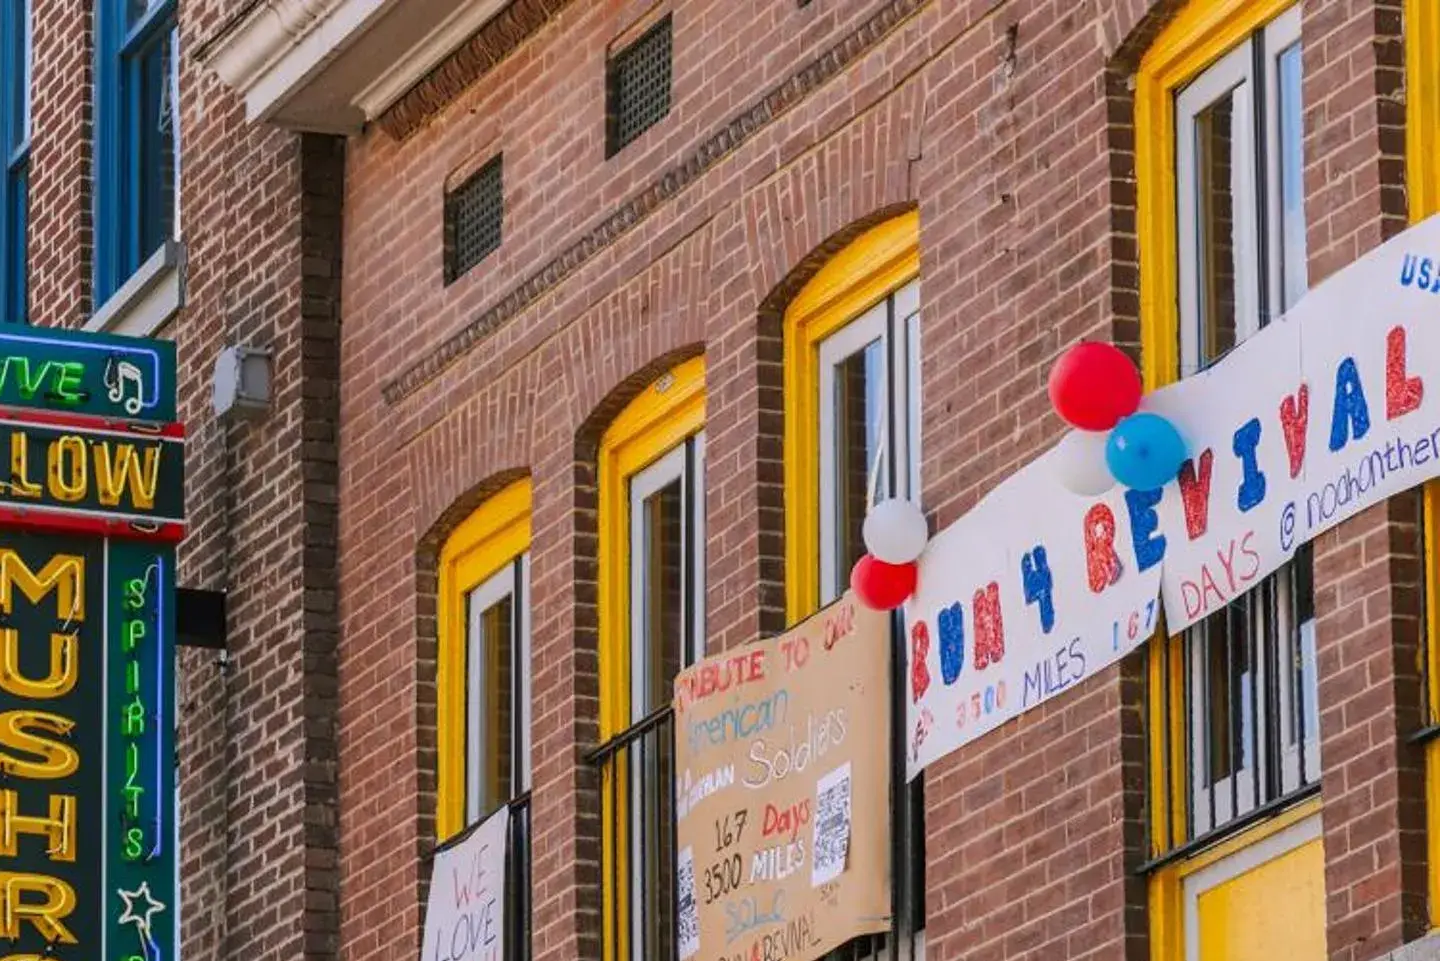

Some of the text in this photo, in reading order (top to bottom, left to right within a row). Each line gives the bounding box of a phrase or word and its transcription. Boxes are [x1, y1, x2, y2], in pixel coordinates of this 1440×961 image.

[1021, 544, 1055, 635] 4
[1083, 325, 1424, 594] REVIVAL
[1022, 637, 1086, 708] MILES
[1180, 530, 1260, 622] DAYS
[121, 577, 146, 860] SPIRITS
[452, 843, 489, 910] WE
[703, 838, 806, 905] 3500 MILES
[714, 799, 810, 853] 167 Days
